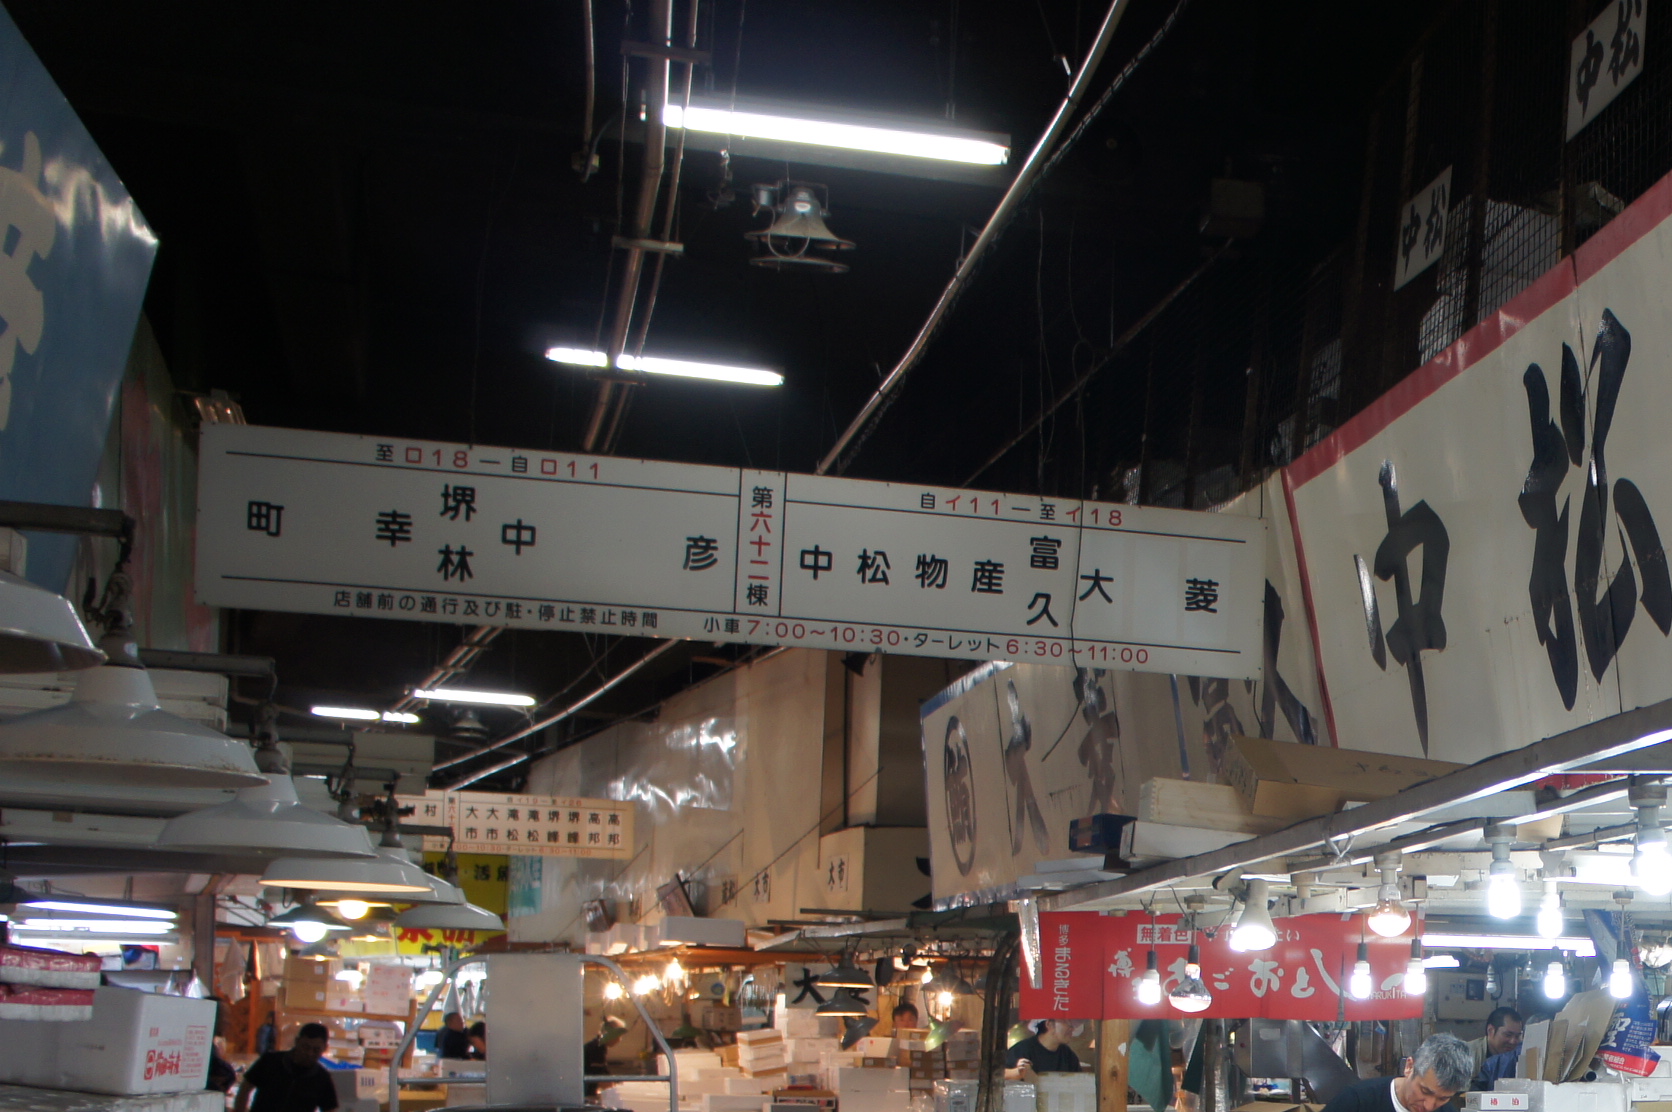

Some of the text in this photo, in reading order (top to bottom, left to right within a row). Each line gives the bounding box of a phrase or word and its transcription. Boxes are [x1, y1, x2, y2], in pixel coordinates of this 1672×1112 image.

[246, 501, 413, 547] 町 幸
[501, 519, 720, 571] 中 彦
[746, 486, 775, 608] 第六十二棟
[799, 544, 1005, 595] 中松物産
[1026, 535, 1062, 629] 富久
[1079, 568, 1220, 614] 大 菱
